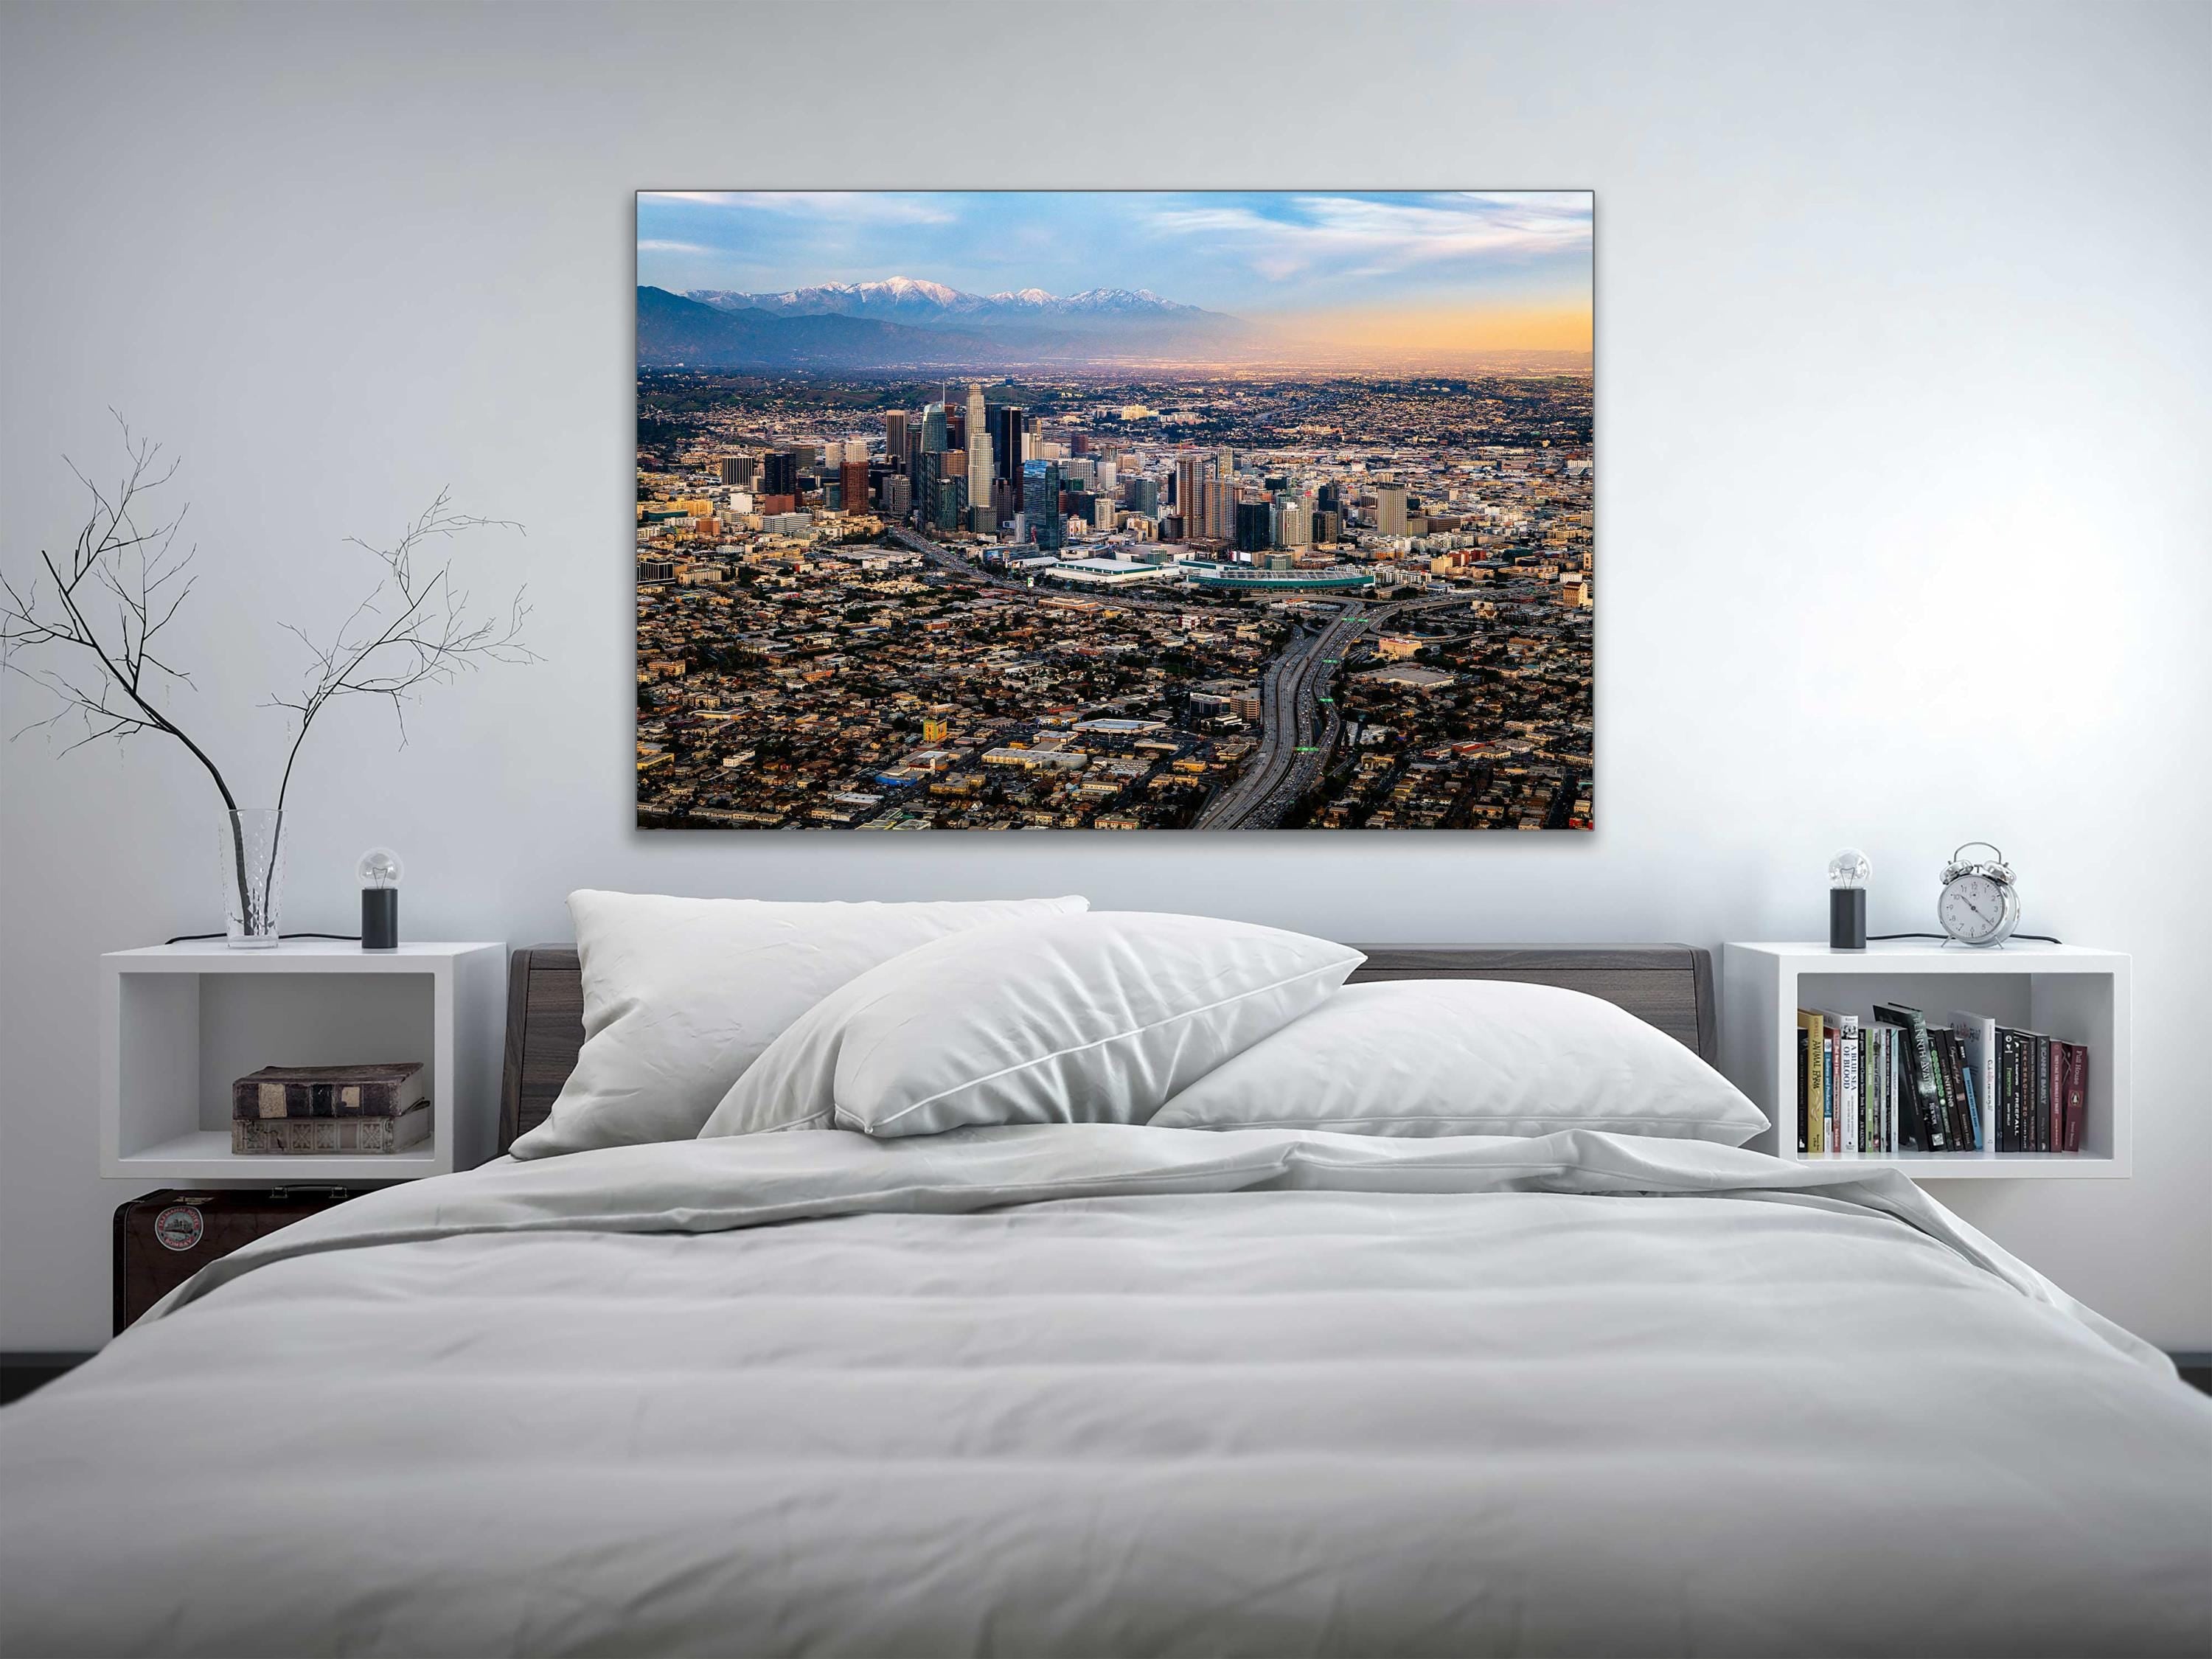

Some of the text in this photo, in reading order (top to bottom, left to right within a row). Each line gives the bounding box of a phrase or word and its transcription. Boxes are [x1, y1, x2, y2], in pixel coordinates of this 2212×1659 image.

[1843, 1046, 1850, 1057] OF
[1915, 1029, 1927, 1058] NINTH
[1812, 1040, 1822, 1089] ANIMAL FARM
[1944, 1075, 1954, 1107] INFERNO
[165, 1238, 192, 1247] BOMBAY
